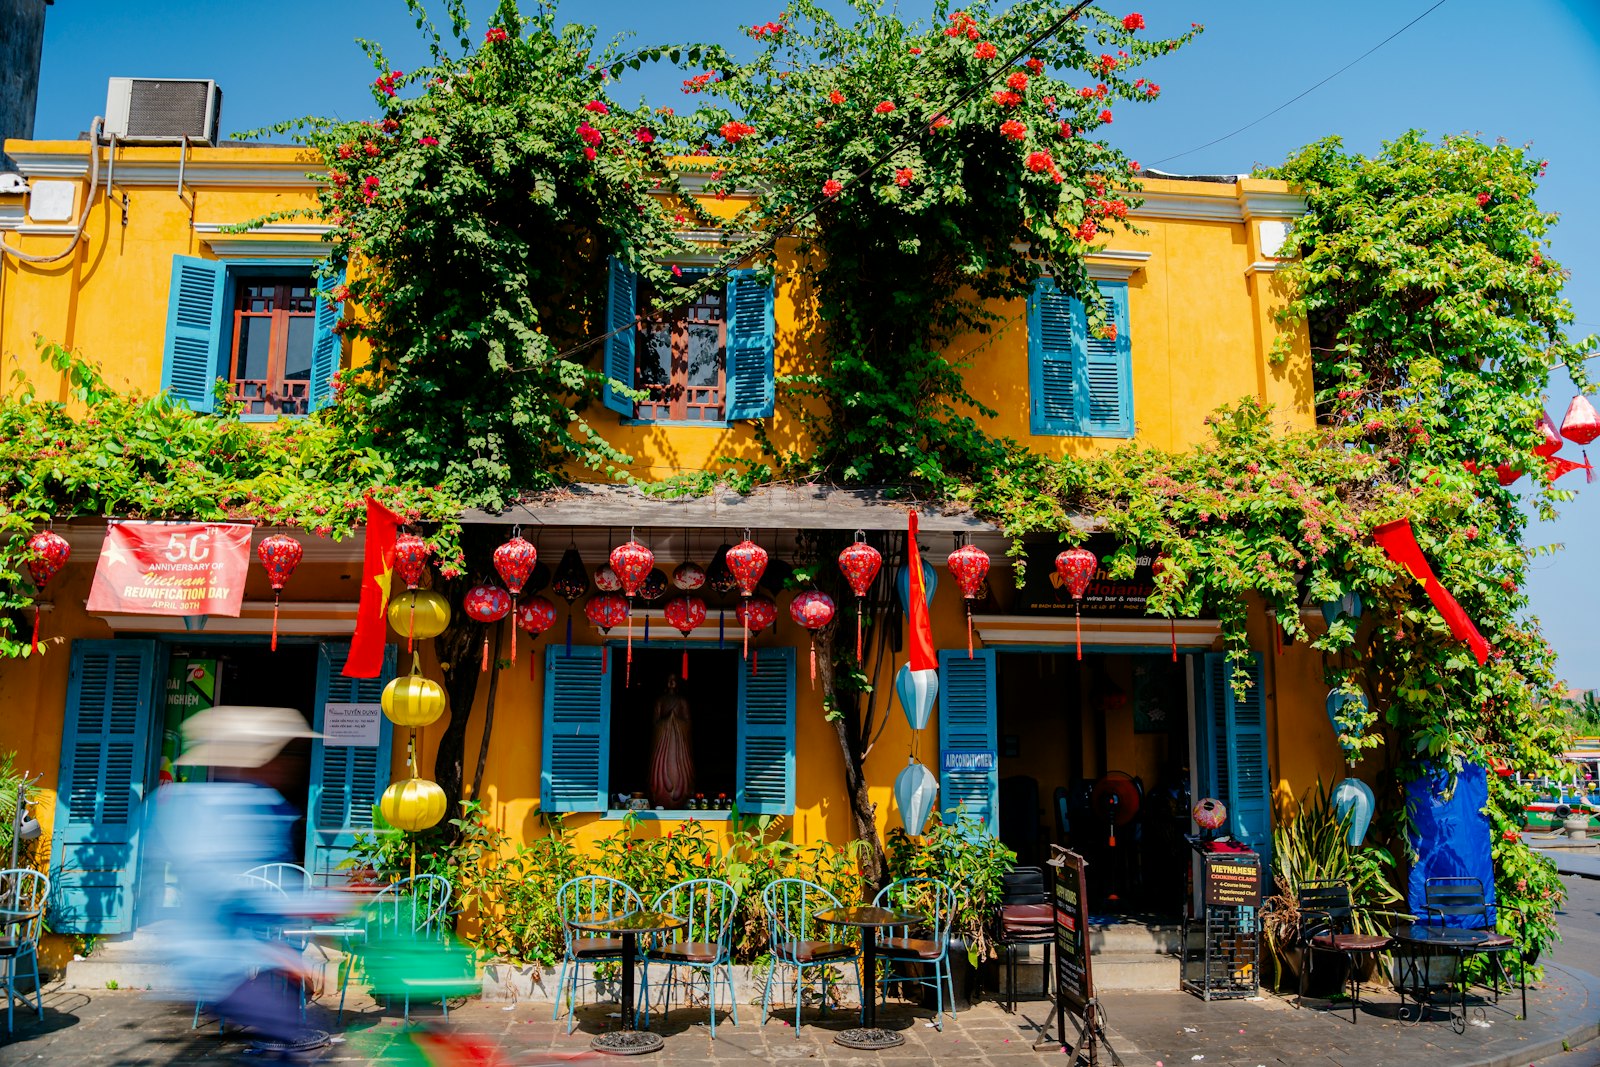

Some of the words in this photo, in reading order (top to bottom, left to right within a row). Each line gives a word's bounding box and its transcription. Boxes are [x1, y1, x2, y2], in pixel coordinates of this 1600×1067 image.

[149, 563, 209, 571] ANNIVERSARY
[211, 562, 224, 570] OF
[142, 571, 218, 586] Vietnam's
[124, 586, 206, 600] REUNIFICATION
[208, 587, 229, 599] DAY
[1087, 582, 1153, 596] Hoiania
[151, 601, 178, 609] APRIL
[167, 693, 200, 707] NGHIỆM
[1211, 864, 1256, 876] VIETNAMESE
